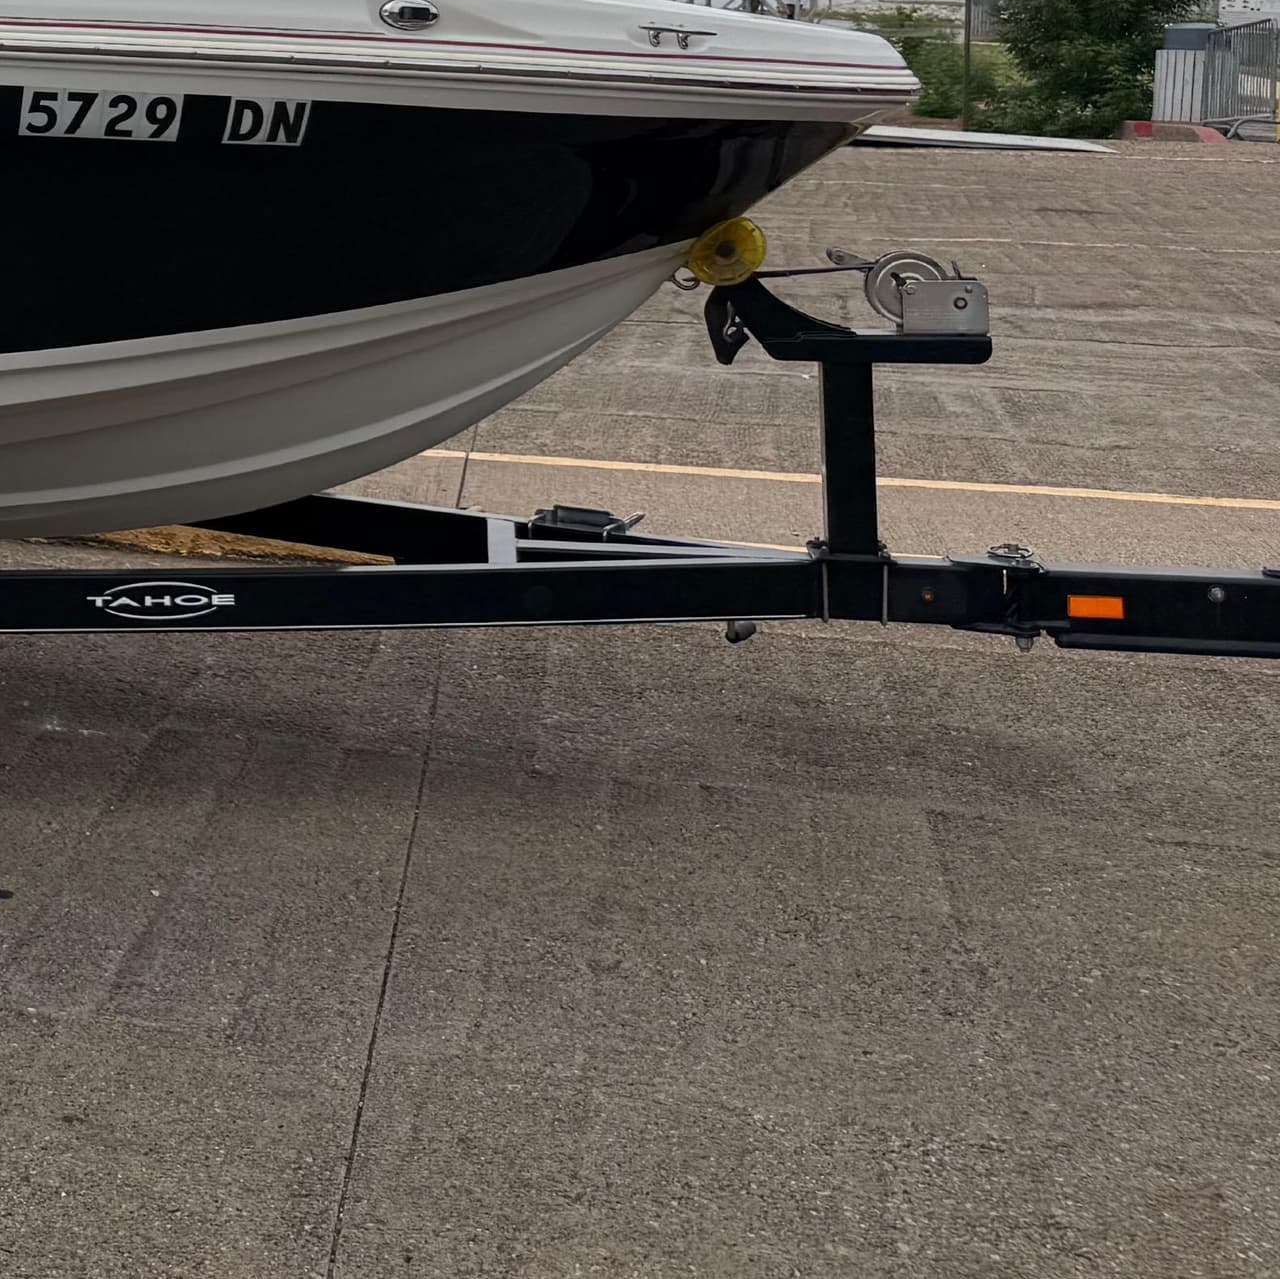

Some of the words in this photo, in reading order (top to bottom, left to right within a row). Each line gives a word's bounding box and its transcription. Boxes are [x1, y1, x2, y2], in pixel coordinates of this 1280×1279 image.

[25, 91, 178, 139] 5729
[227, 99, 307, 143] DN
[86, 594, 235, 607] TAHOE
